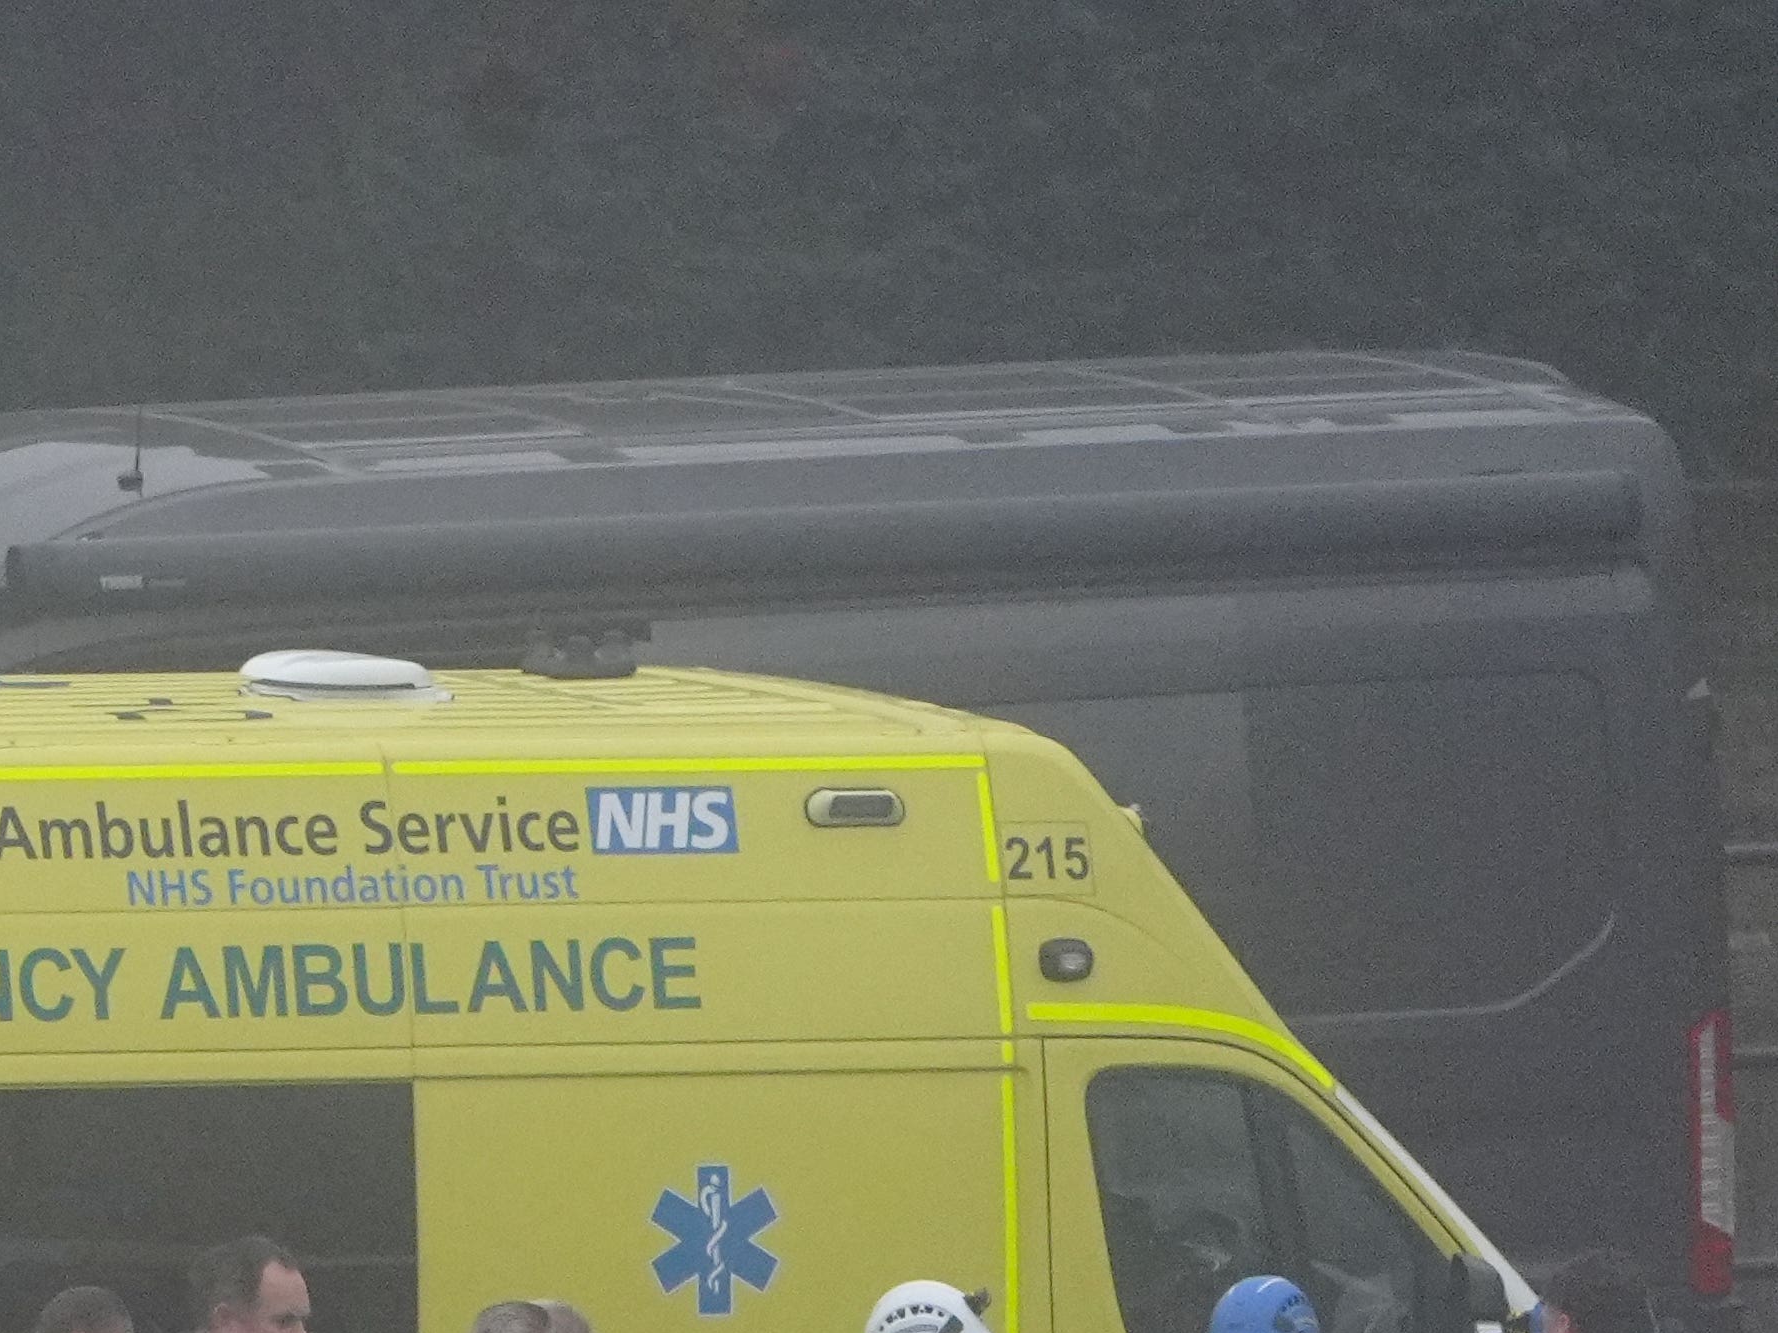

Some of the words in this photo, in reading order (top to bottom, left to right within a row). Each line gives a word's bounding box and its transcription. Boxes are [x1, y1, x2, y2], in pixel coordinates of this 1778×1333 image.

[359, 796, 580, 855] Service
[595, 790, 732, 850] NHS
[126, 867, 214, 907] NHS
[227, 864, 465, 906] Foundation
[475, 863, 580, 900] Trust
[1005, 836, 1089, 881] 215
[158, 936, 704, 1021] AMBULANCE
